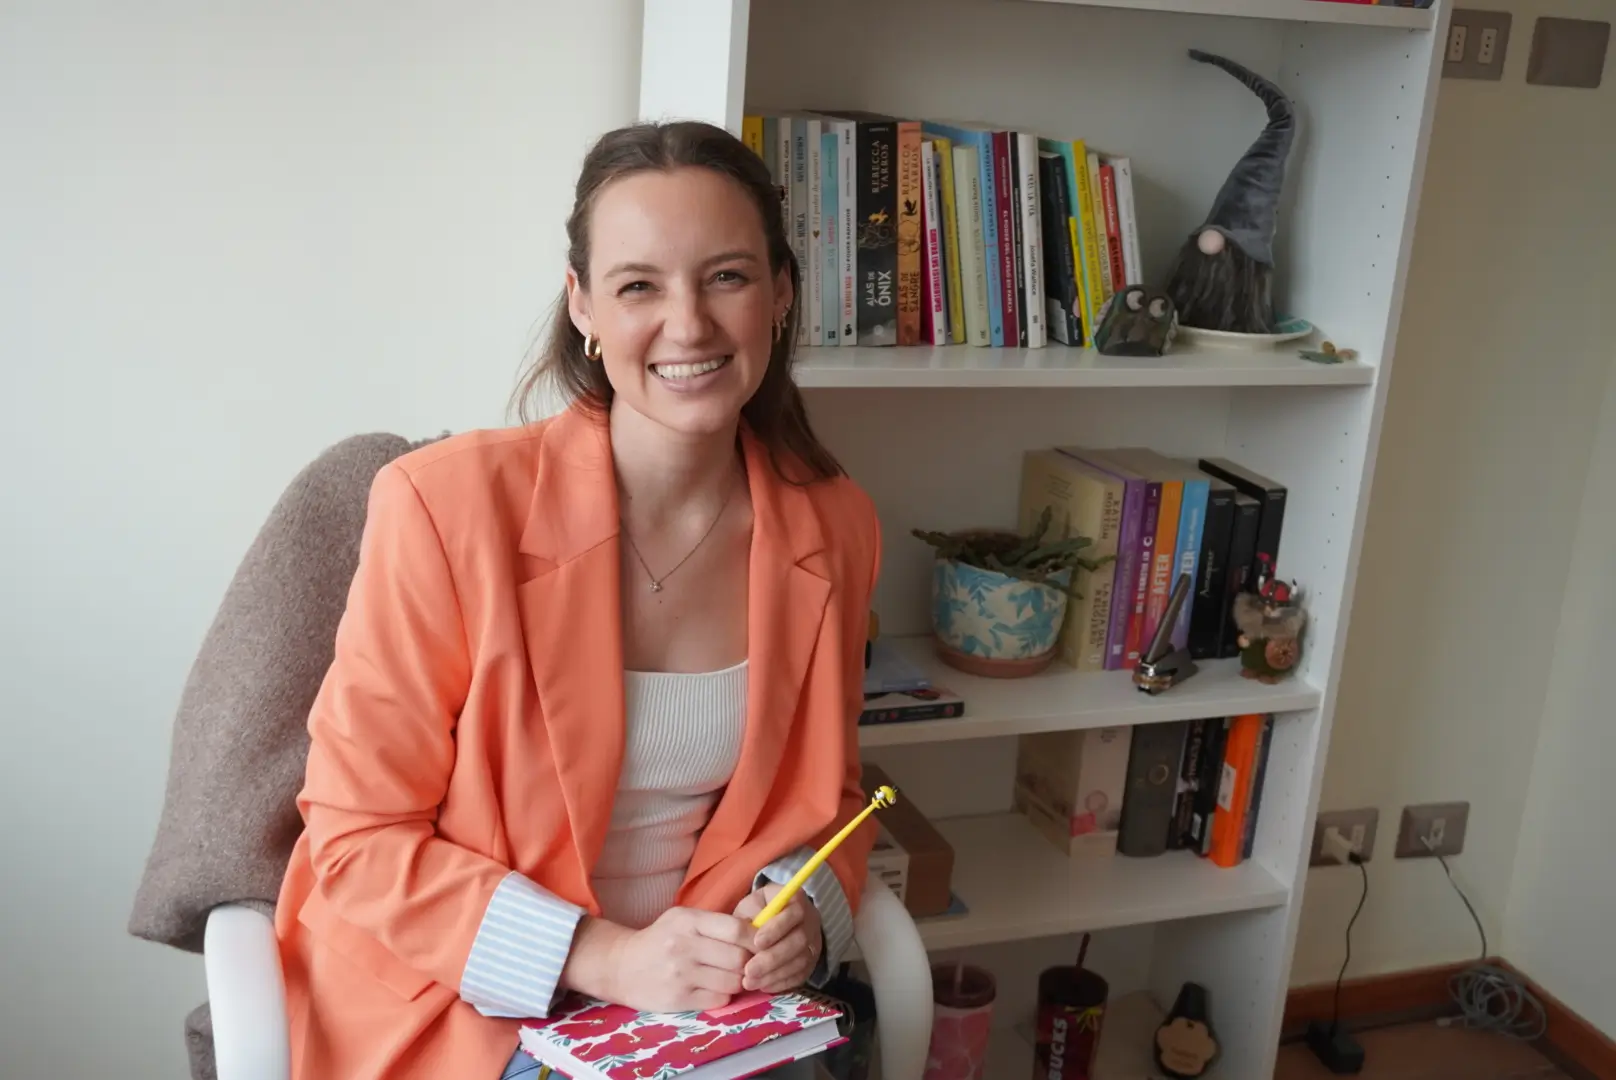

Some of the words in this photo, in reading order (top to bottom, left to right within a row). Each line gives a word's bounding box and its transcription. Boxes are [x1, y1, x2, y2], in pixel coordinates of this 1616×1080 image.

[872, 140, 880, 193] REBECCA
[881, 144, 889, 188] YARROS
[902, 143, 910, 195] REBECCA
[911, 146, 919, 191] YARROS
[1002, 209, 1009, 218] EL
[1002, 219, 1010, 241] PODER
[1004, 255, 1012, 278] APEGO
[1029, 244, 1037, 267] Josefa
[867, 271, 875, 280] DE
[875, 270, 892, 306] ÓNIX
[900, 271, 908, 282] DE
[1030, 268, 1038, 295] Wallace
[867, 282, 875, 307] ALAS
[900, 285, 908, 313] ALAS
[910, 271, 919, 313] SANGRE
[1102, 492, 1113, 539] MORTON
[1111, 500, 1120, 529] KATE
[1152, 553, 1170, 595] AFTER
[1102, 583, 1110, 597] LA
[1090, 589, 1102, 645] RELOJERO
[1099, 599, 1108, 626] HIJA
[1097, 628, 1105, 648] DEL
